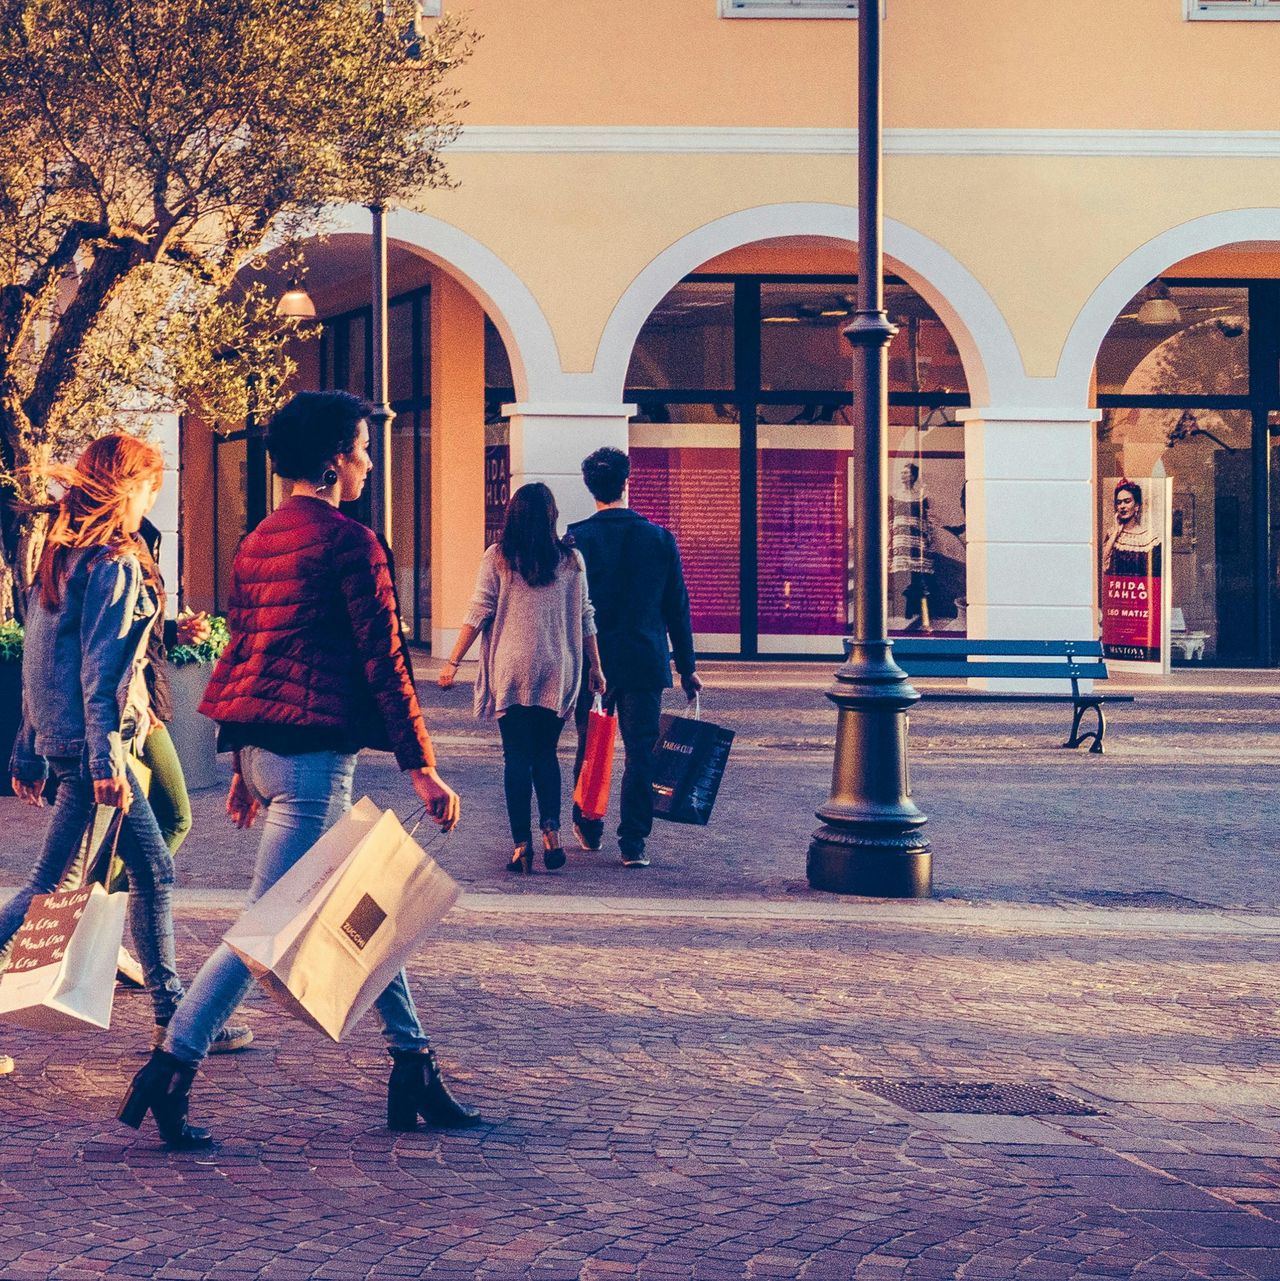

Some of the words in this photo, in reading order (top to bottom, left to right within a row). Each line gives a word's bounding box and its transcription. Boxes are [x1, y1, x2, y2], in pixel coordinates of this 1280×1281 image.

[486, 483, 507, 505] HLO
[1109, 581, 1146, 591] FRIDA
[1108, 590, 1148, 600] KAHLO
[1121, 609, 1150, 618] MATIZ
[342, 922, 366, 948] ZUCCHI
